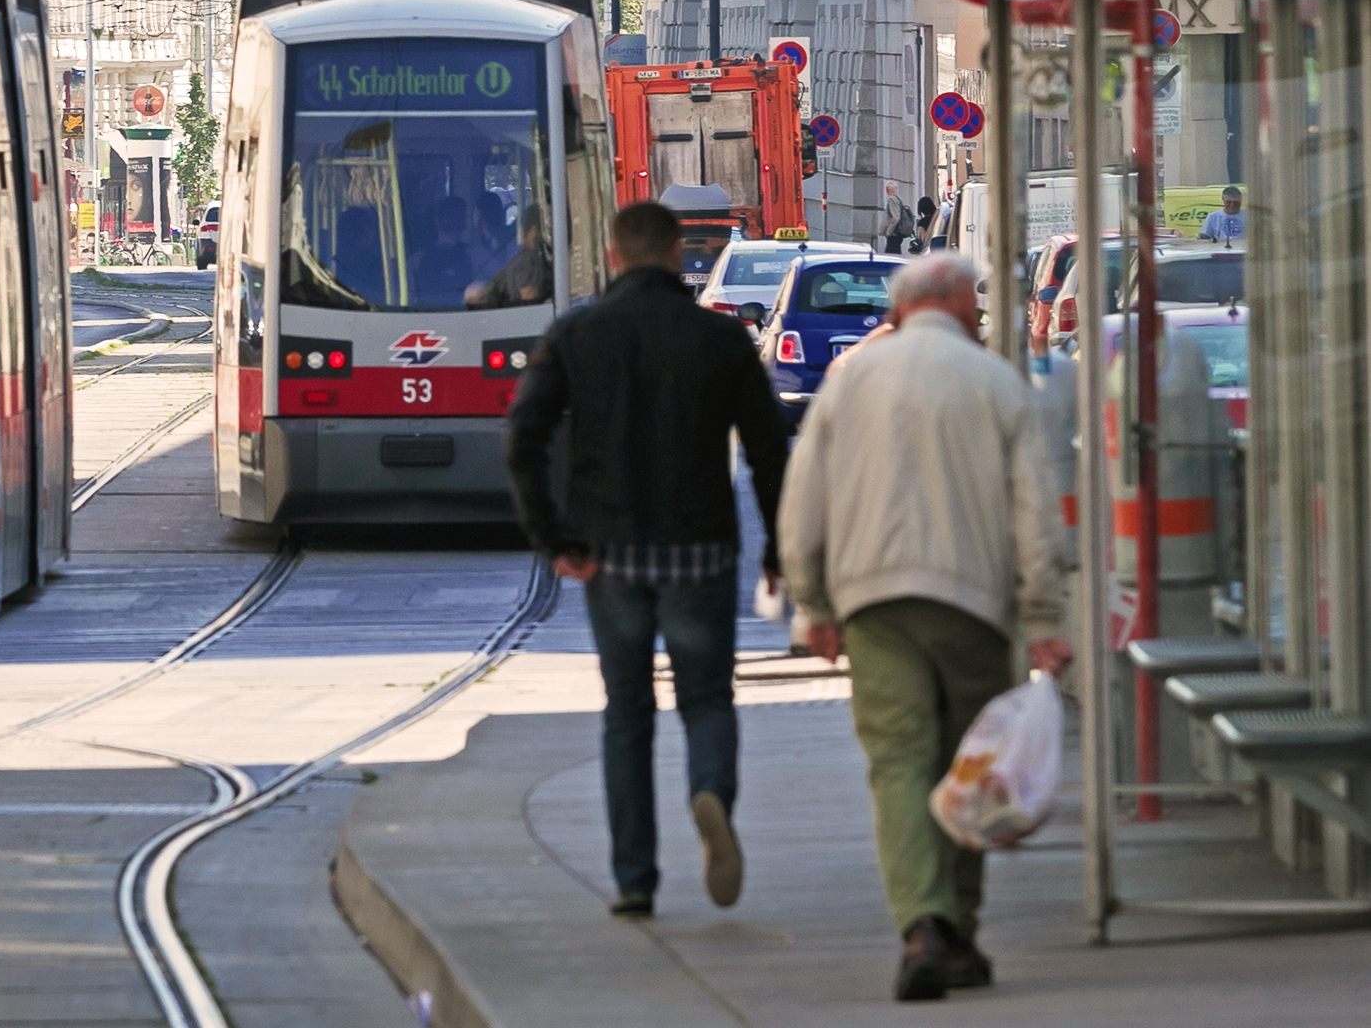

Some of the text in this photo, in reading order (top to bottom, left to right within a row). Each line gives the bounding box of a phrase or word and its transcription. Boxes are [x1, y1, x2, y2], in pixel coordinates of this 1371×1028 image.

[318, 64, 343, 102] 44
[349, 65, 468, 96] Schottentor
[941, 133, 958, 141] Ende
[402, 378, 432, 403] 53
